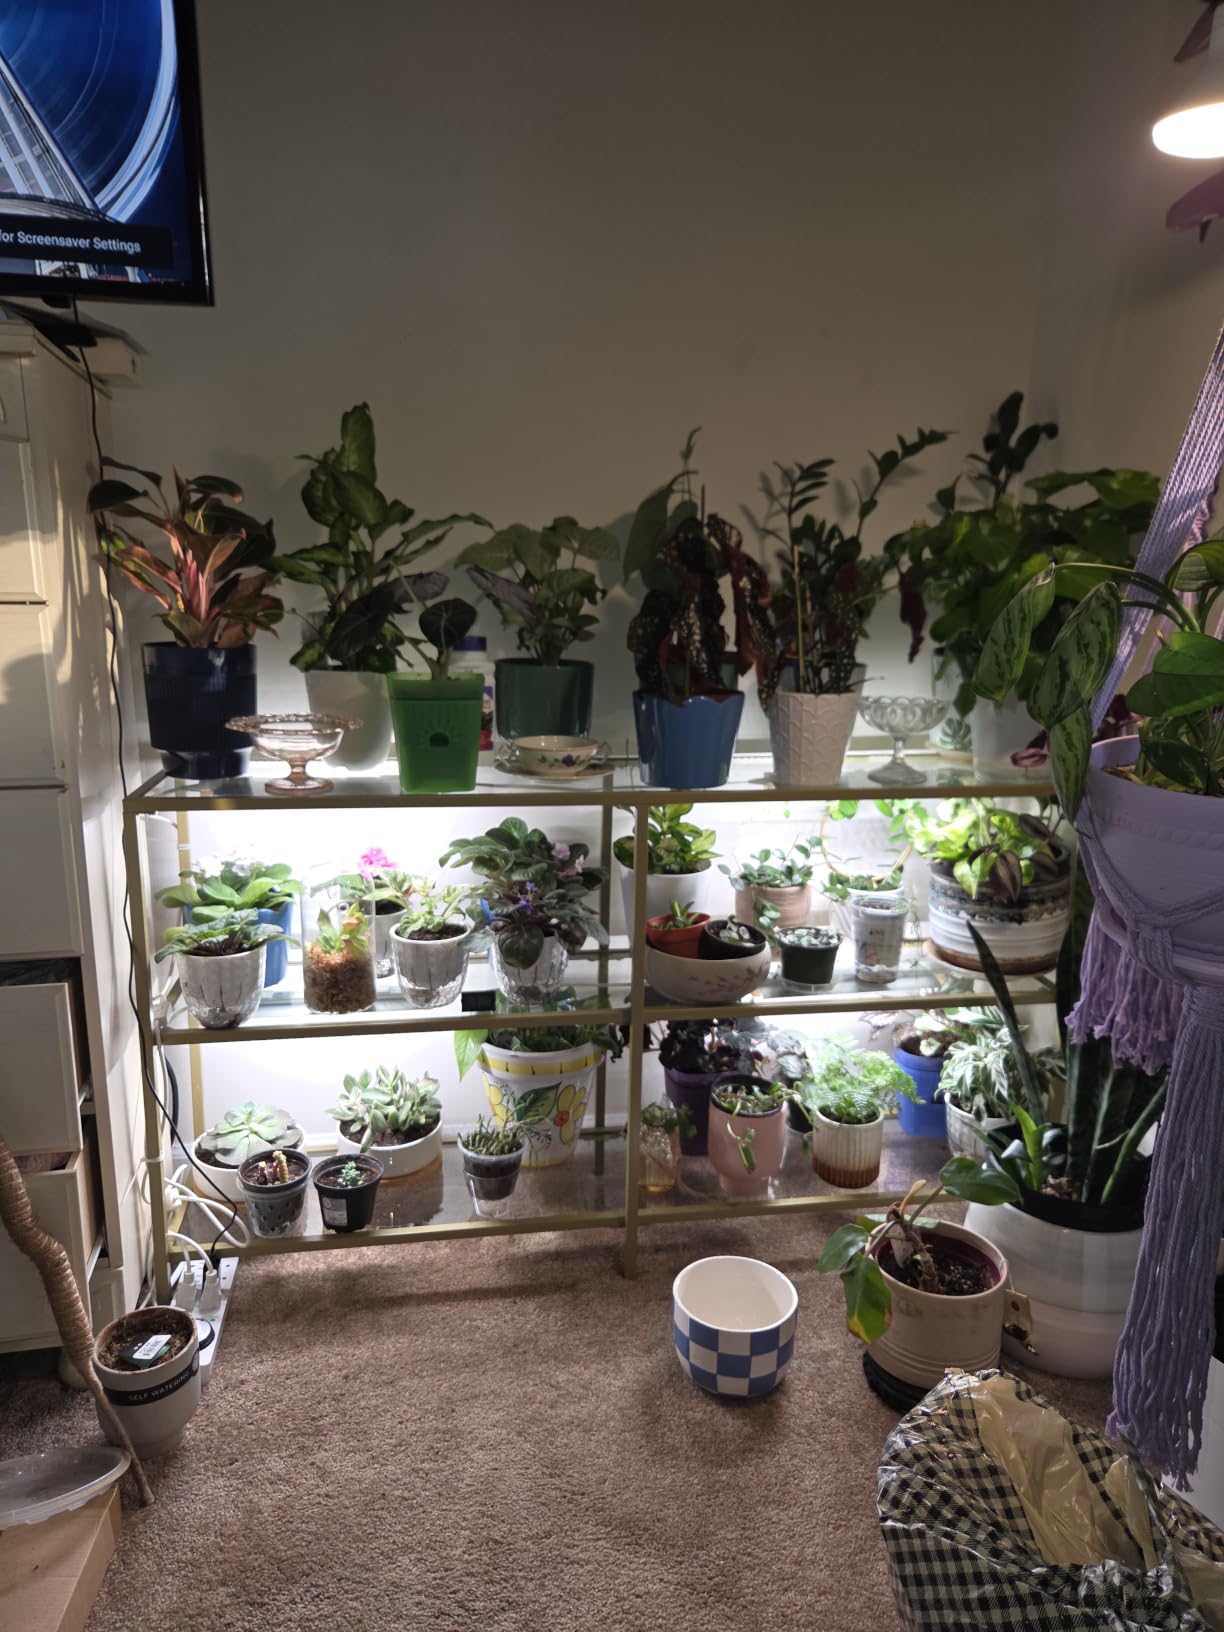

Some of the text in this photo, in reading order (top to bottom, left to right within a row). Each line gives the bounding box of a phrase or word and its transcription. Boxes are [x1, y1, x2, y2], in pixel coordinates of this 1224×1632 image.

[17, 231, 91, 248] Screensaver
[93, 237, 141, 254] Settings
[128, 1393, 148, 1401] SELF
